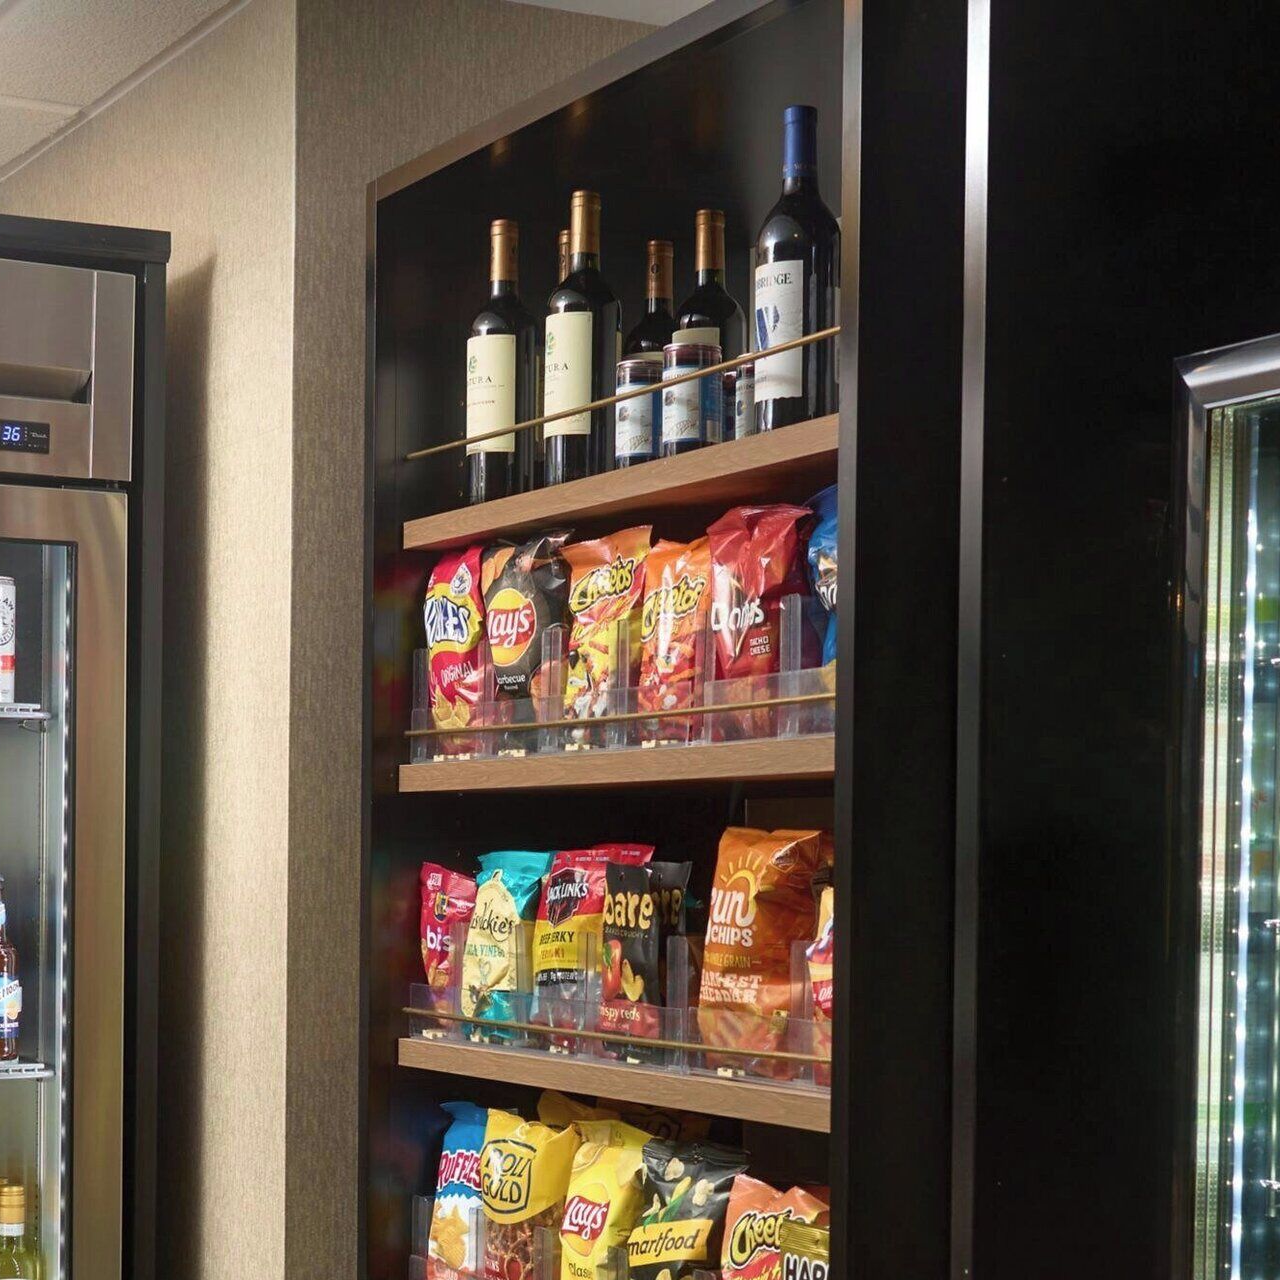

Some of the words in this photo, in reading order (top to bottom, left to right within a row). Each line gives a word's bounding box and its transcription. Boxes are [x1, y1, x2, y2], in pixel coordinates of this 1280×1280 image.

[3, 426, 20, 441] 36
[604, 891, 653, 929] bare
[437, 1150, 482, 1190] RUFFLES
[482, 1172, 521, 1203] GOLD
[562, 1196, 608, 1241] Lay's
[628, 1228, 701, 1258] martfood
